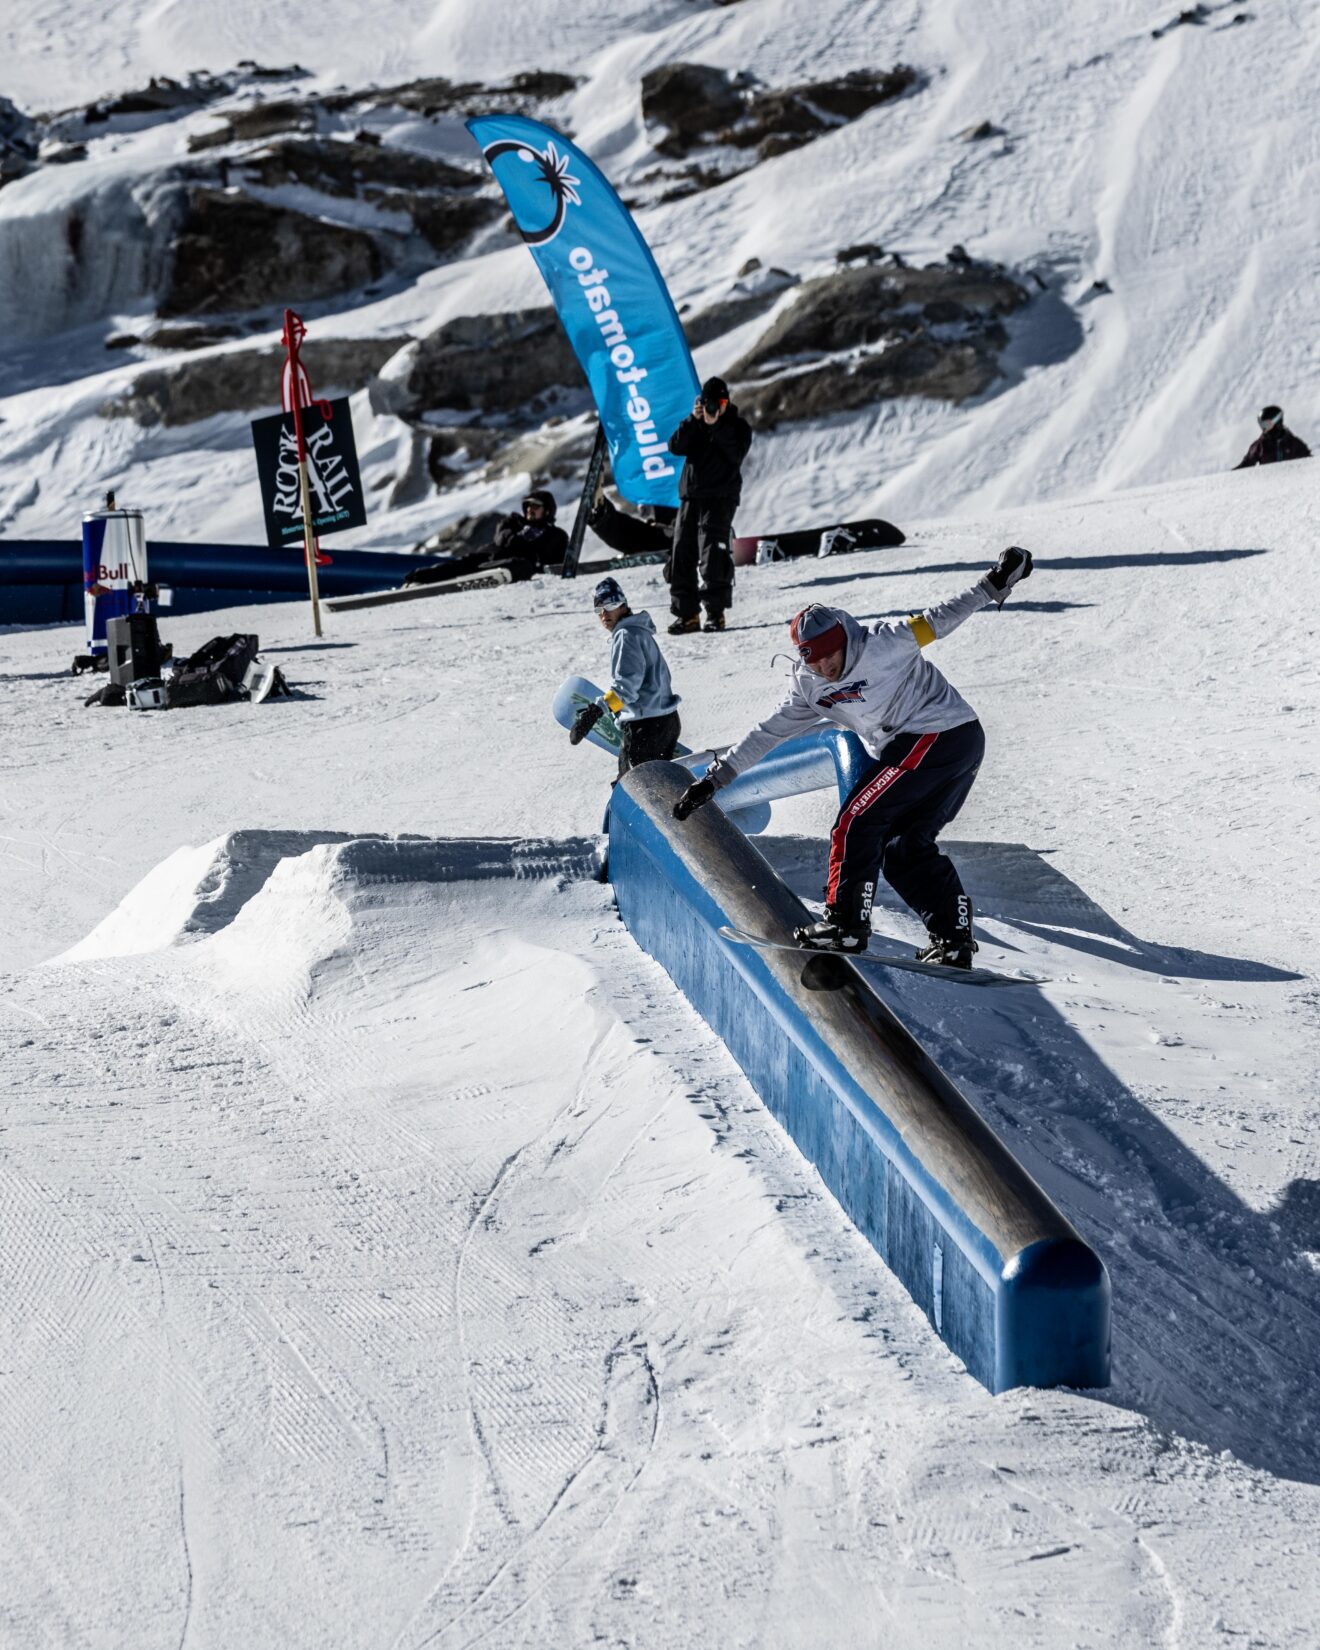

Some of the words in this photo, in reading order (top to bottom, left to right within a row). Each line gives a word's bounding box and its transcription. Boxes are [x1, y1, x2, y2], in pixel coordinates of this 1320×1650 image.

[272, 424, 300, 513] ROCK
[305, 422, 354, 512] RAIL
[98, 563, 128, 580] Bull
